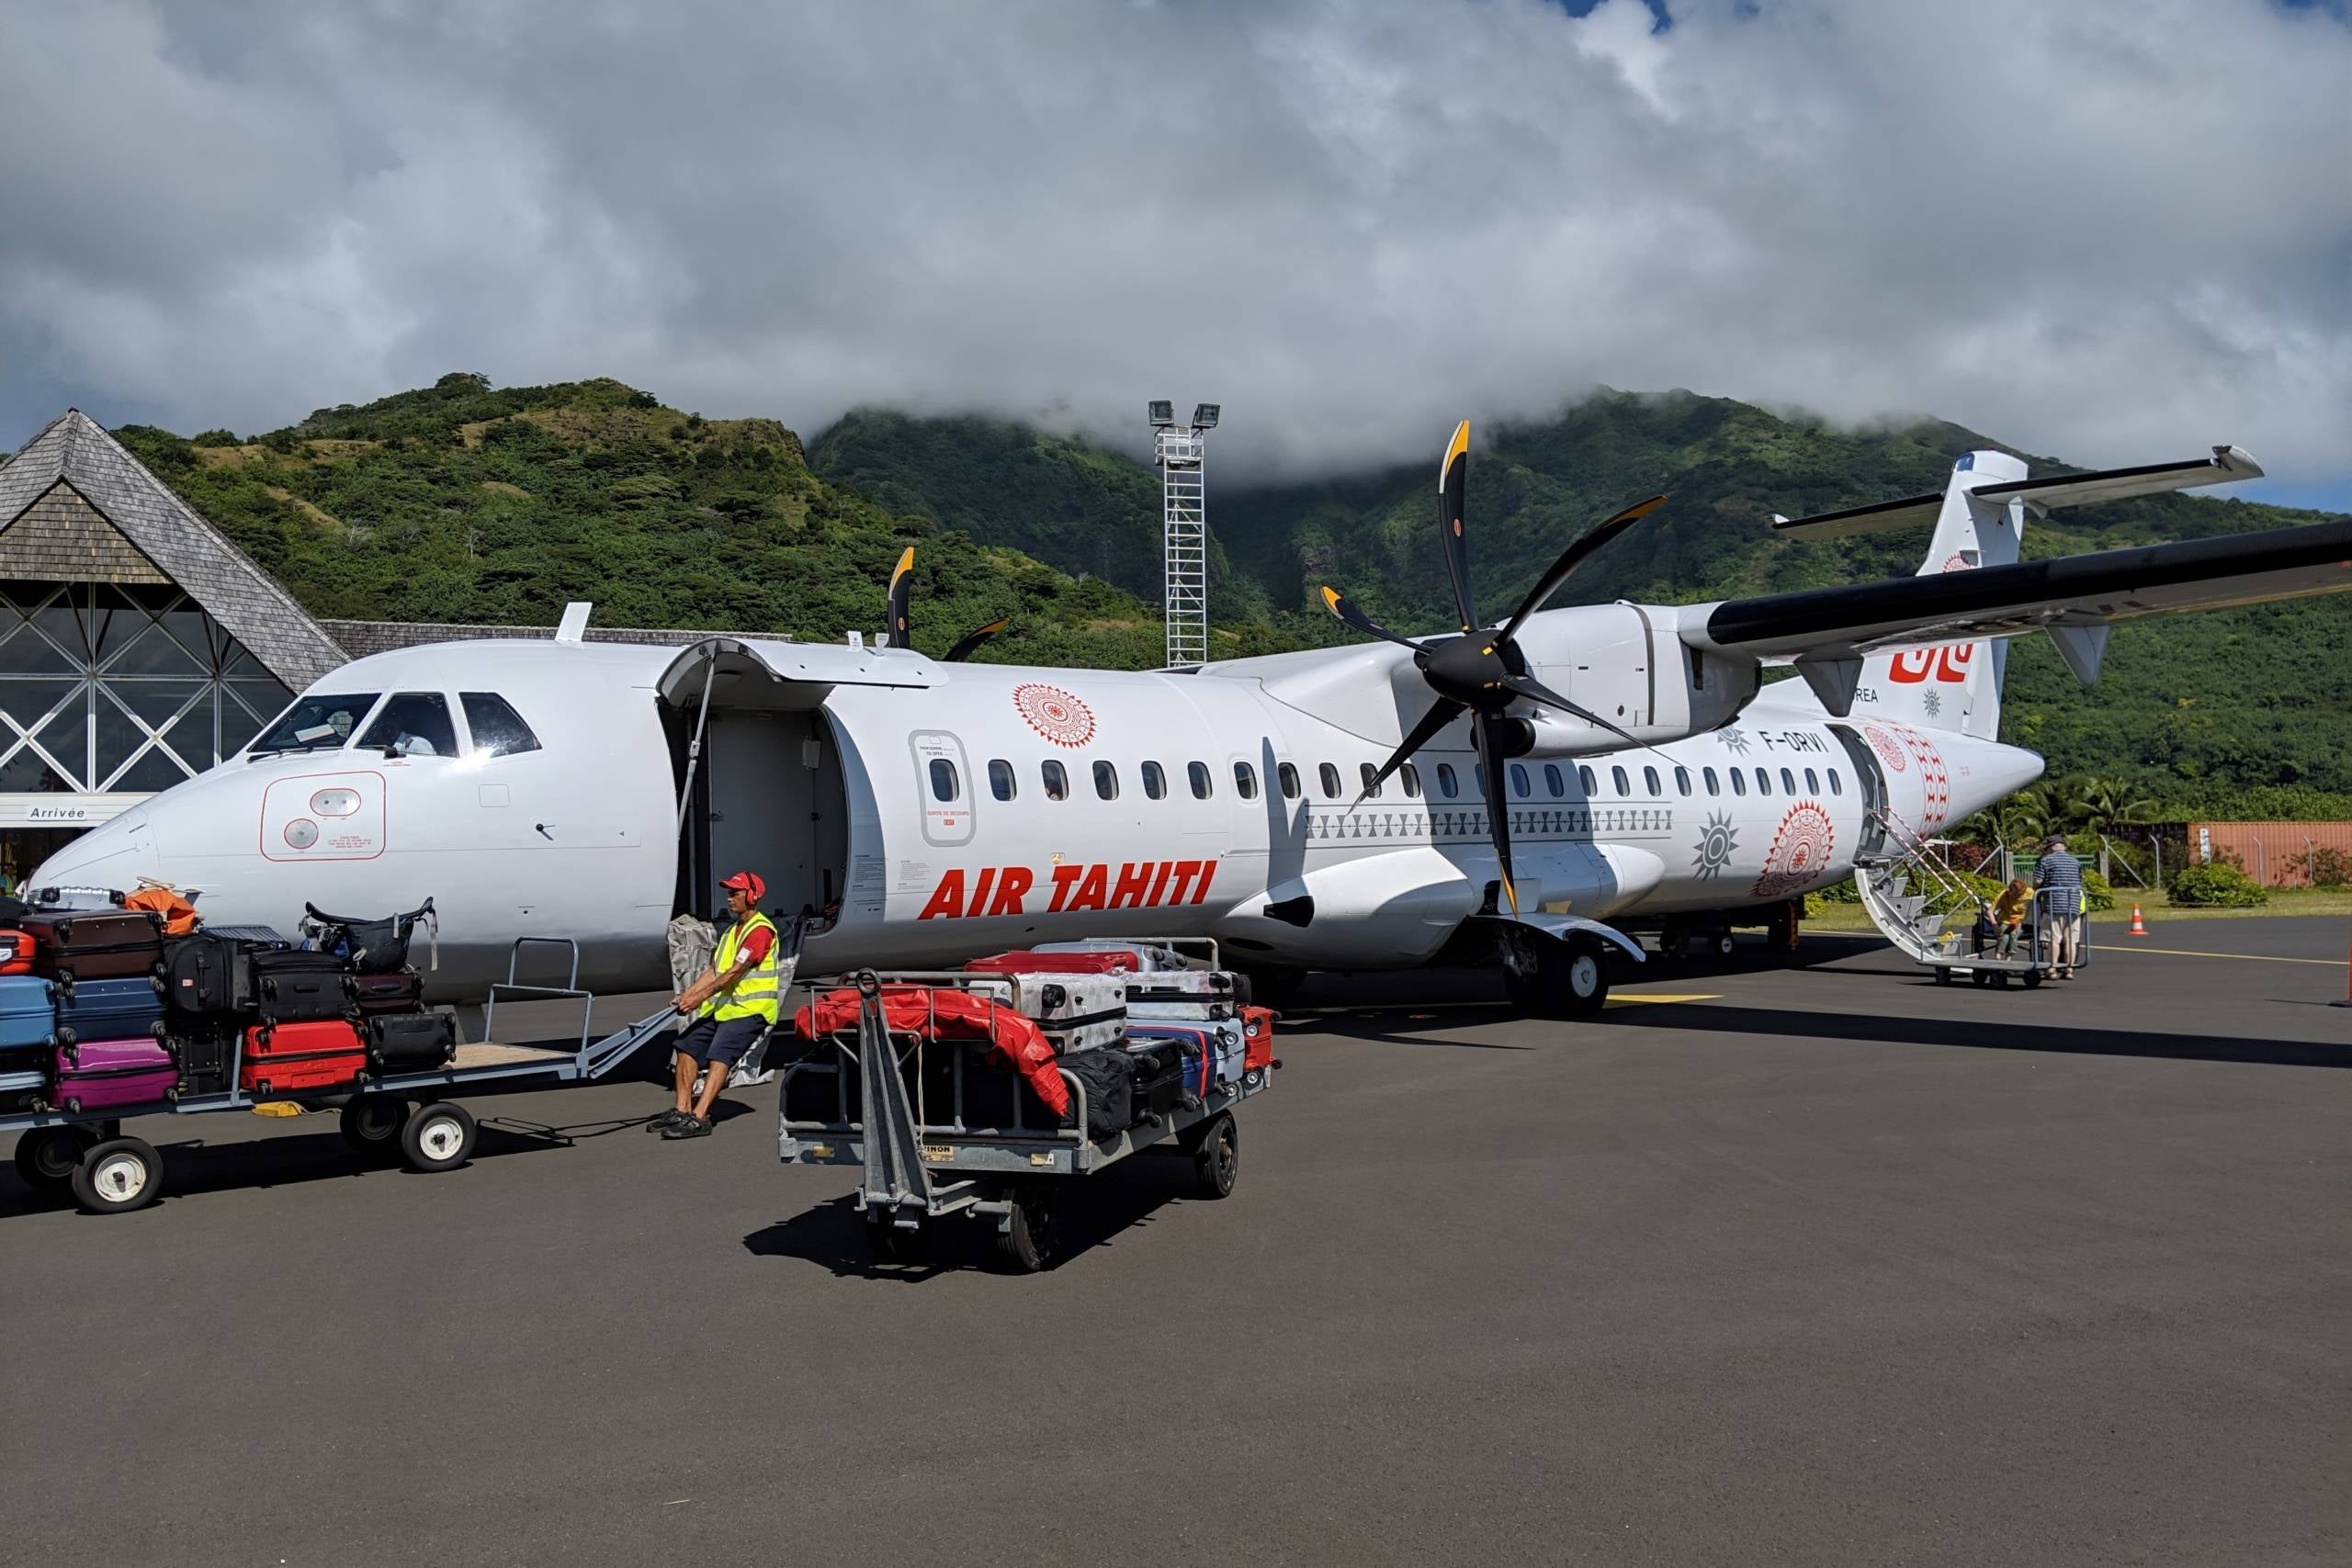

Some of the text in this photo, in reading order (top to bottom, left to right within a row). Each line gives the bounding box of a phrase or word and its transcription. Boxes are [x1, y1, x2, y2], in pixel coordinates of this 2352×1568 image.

[1855, 687, 1879, 704] REA
[1758, 730, 1830, 753] F-ORVI
[30, 807, 85, 818] Arrivée
[917, 867, 1034, 920] AIR
[1046, 860, 1218, 913] TAHITI
